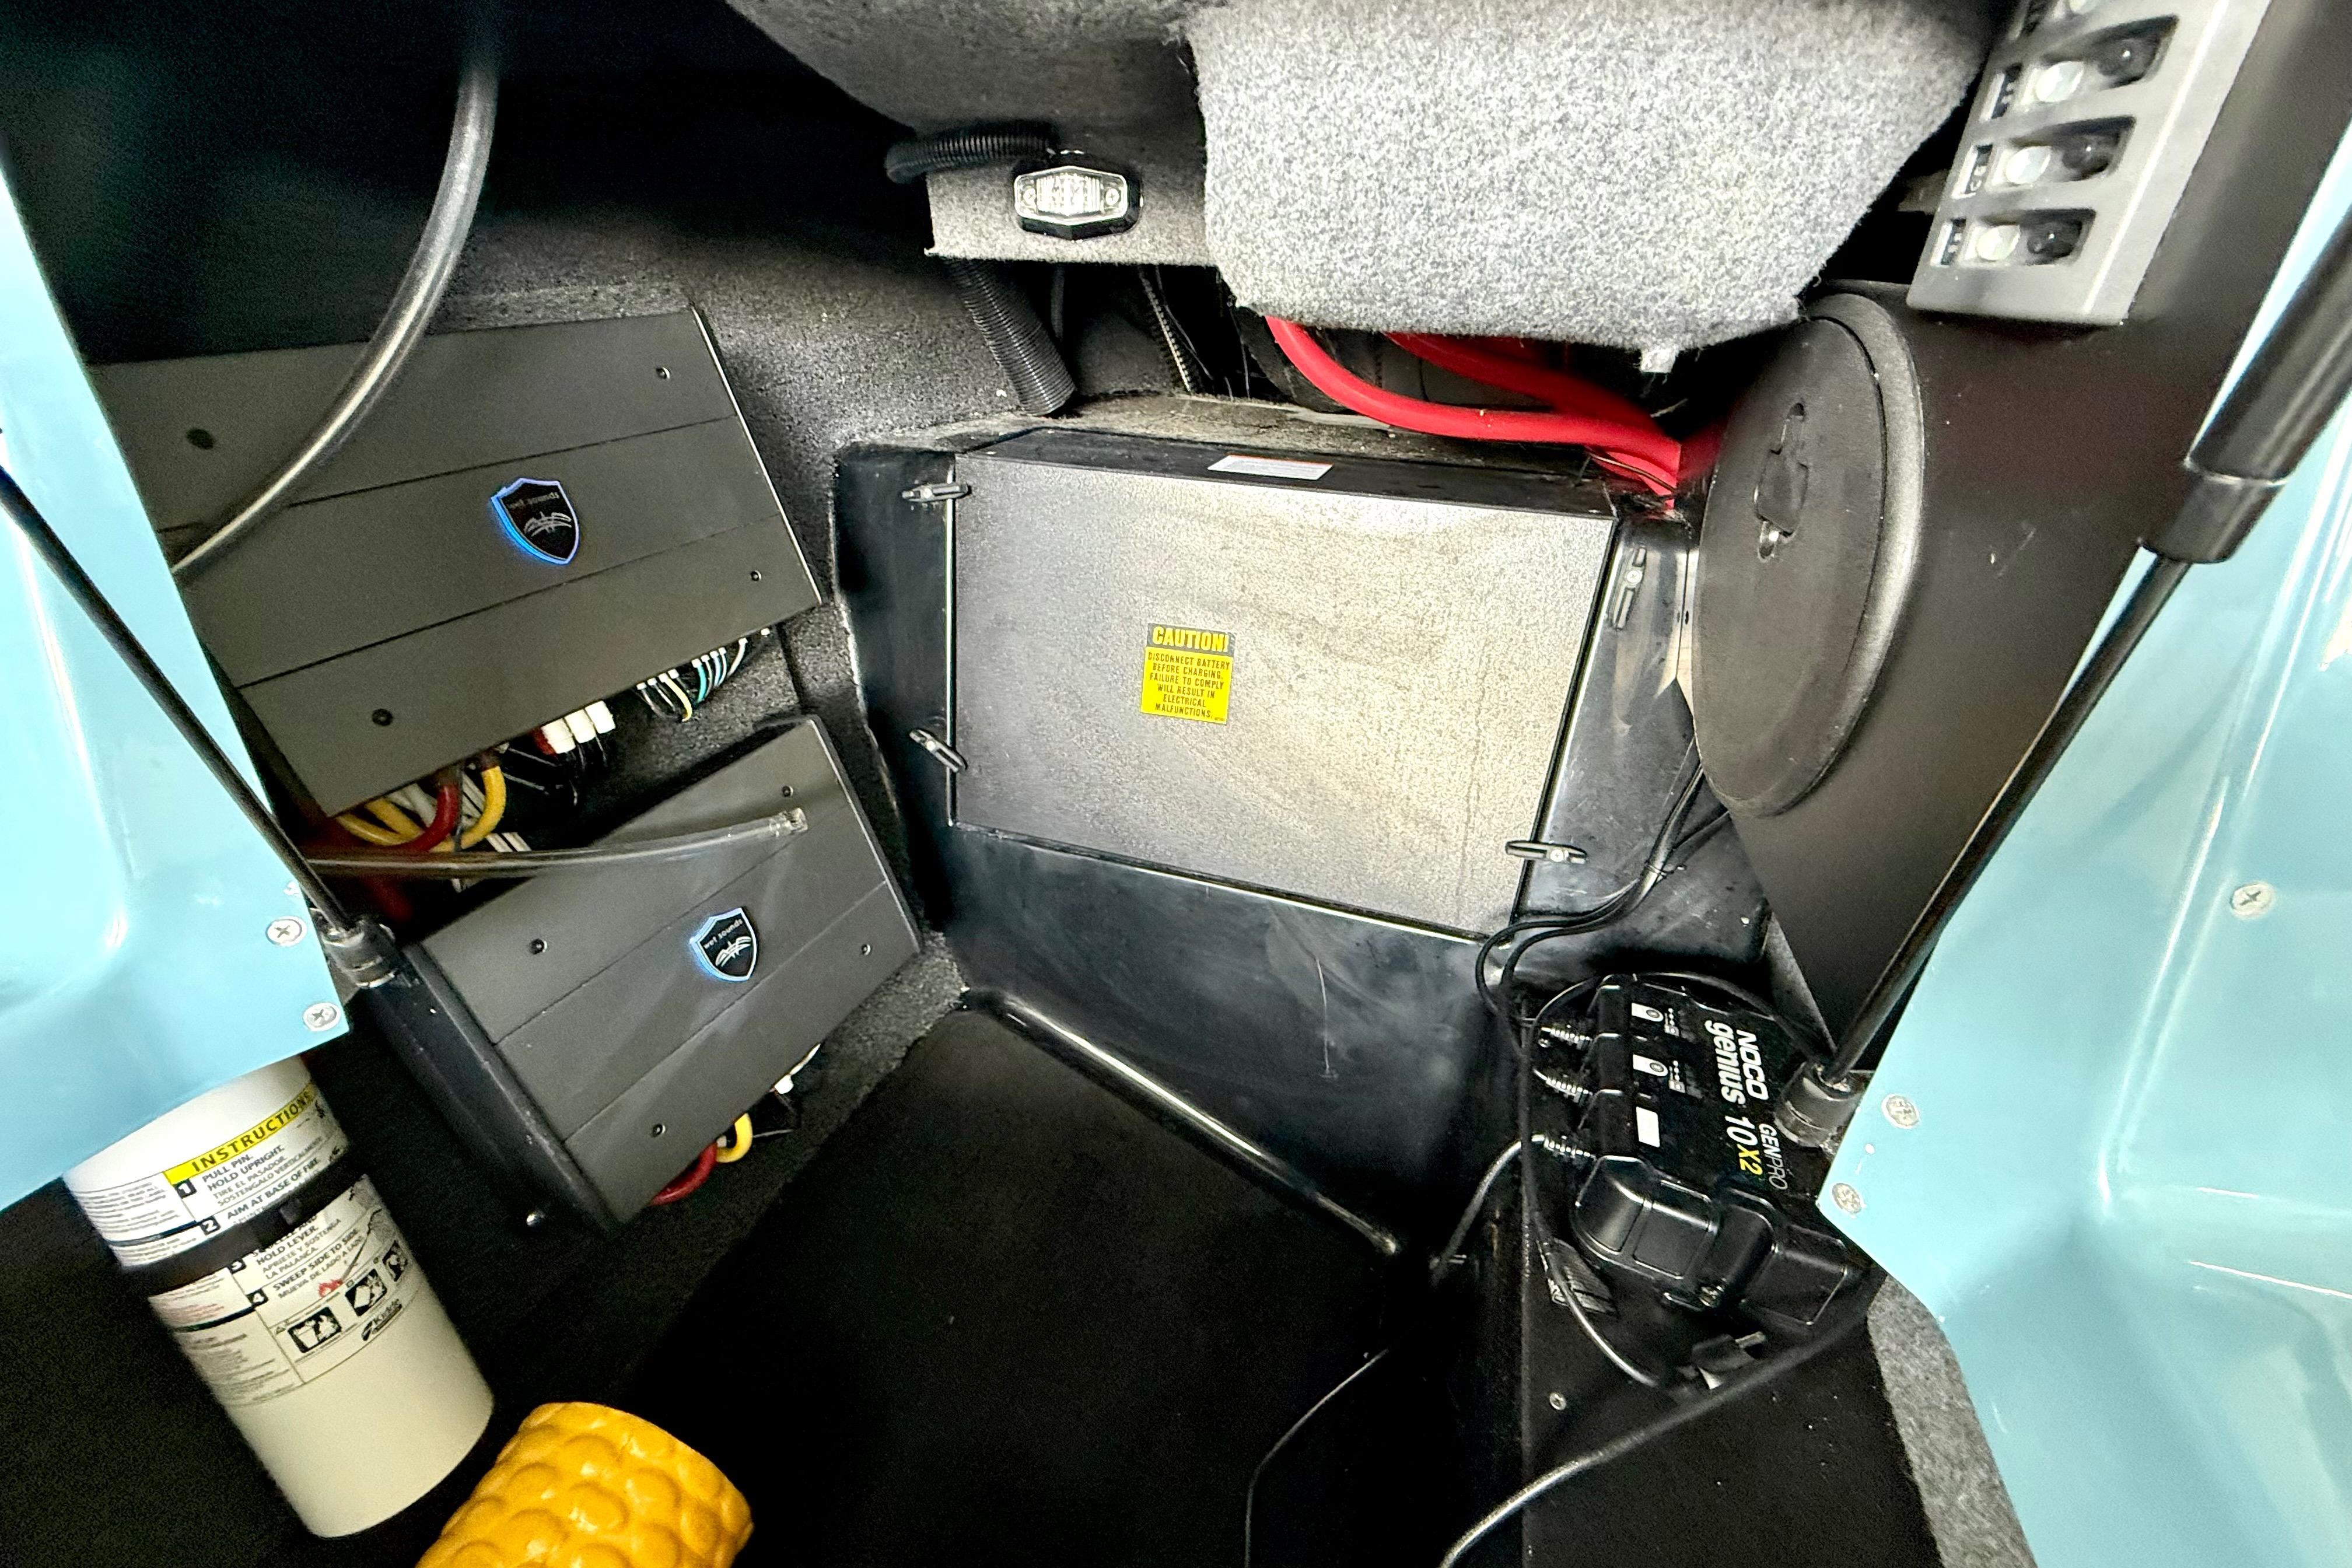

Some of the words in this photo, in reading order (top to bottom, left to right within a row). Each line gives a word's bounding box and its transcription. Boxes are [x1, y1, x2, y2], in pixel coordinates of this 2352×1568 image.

[1153, 626, 1229, 653] CAUTION!
[1147, 652, 1194, 665] DISCONNECT
[1197, 658, 1230, 670] BATTERY
[1153, 663, 1180, 674] BEFORE
[1183, 667, 1223, 680] CHARGING.
[1150, 673, 1178, 684] FAILURE
[1183, 677, 1192, 685] TO
[1195, 678, 1224, 690] COMPLY
[1157, 683, 1174, 693] WILL
[1177, 686, 1205, 697] RESULT
[1163, 694, 1206, 708] ELECTRICAL
[1155, 704, 1213, 719] MALFUNCTIONS.
[703, 936, 718, 949] wet
[718, 919, 743, 939] sounds
[1704, 1020, 1746, 1105] genius
[1736, 1029, 1769, 1101] NOCO
[191, 1090, 313, 1172] INSTRUCTIONS
[1758, 1123, 1788, 1191] GENPRO
[202, 1166, 231, 1183] PULL
[230, 1154, 253, 1168] PIN.
[178, 1182, 192, 1195] 1
[207, 1172, 239, 1191] HOLD
[213, 1186, 233, 1199] TIRE
[235, 1180, 246, 1189] EL
[217, 1172, 275, 1206] SOSTENGALO
[227, 1203, 249, 1220] AIM
[251, 1195, 264, 1207] AT
[264, 1178, 291, 1198] BASE
[290, 1170, 303, 1182] OF
[202, 1219, 216, 1232] 2
[256, 1245, 286, 1265] HOLD
[265, 1270, 279, 1280] LA
[272, 1267, 308, 1292] SWEEP
[308, 1251, 330, 1270] SIDE
[330, 1242, 342, 1255] TO
[309, 1270, 322, 1280] DE
[253, 1293, 265, 1303] 4
